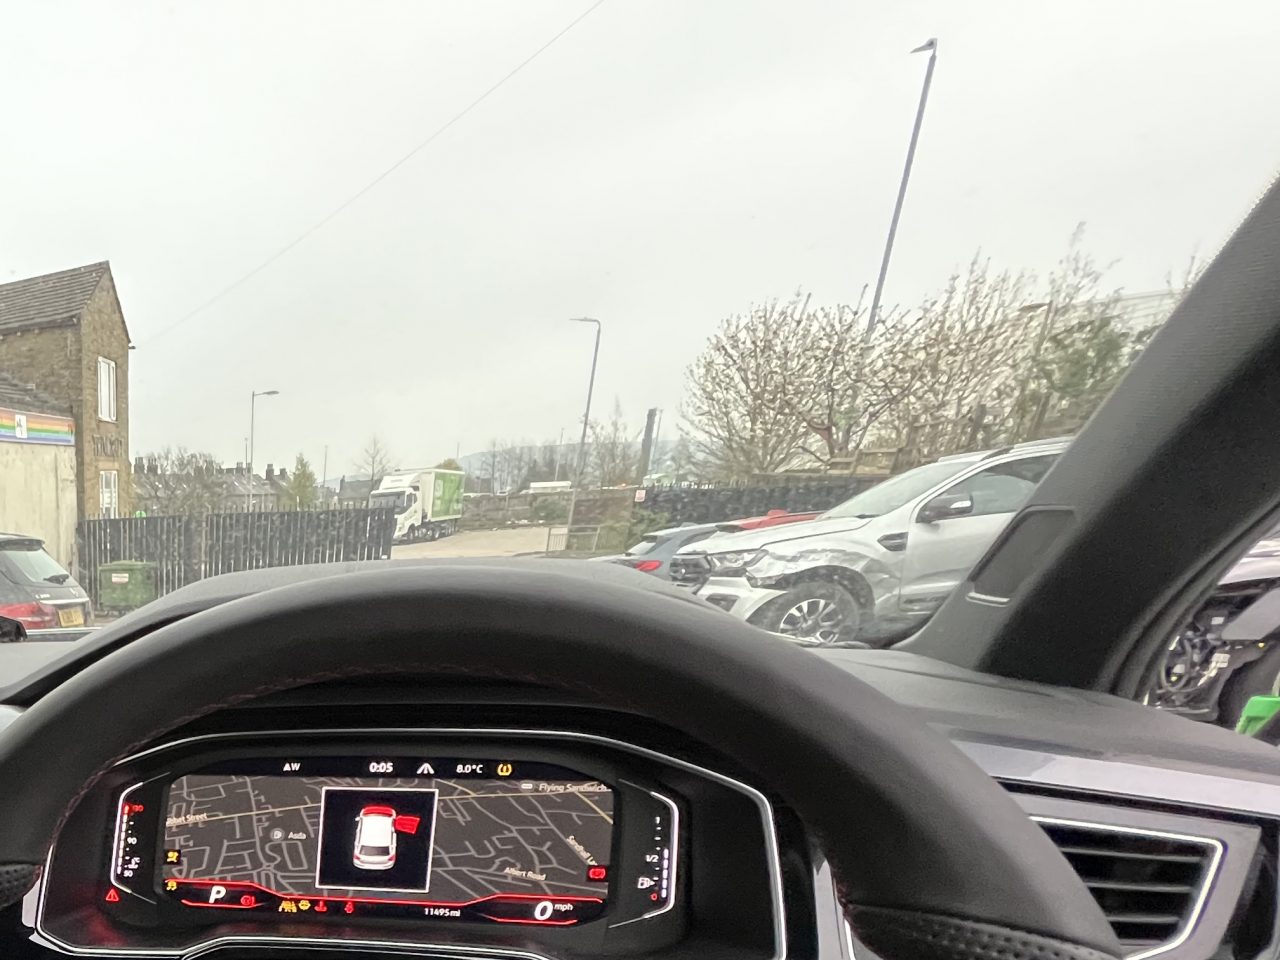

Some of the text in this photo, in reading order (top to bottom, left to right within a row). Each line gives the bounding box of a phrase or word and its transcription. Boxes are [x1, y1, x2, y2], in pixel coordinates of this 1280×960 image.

[369, 762, 393, 773] 0:05
[539, 783, 564, 792] Flying
[288, 832, 307, 840] Asda
[208, 886, 226, 904] P
[534, 901, 553, 920] 0
